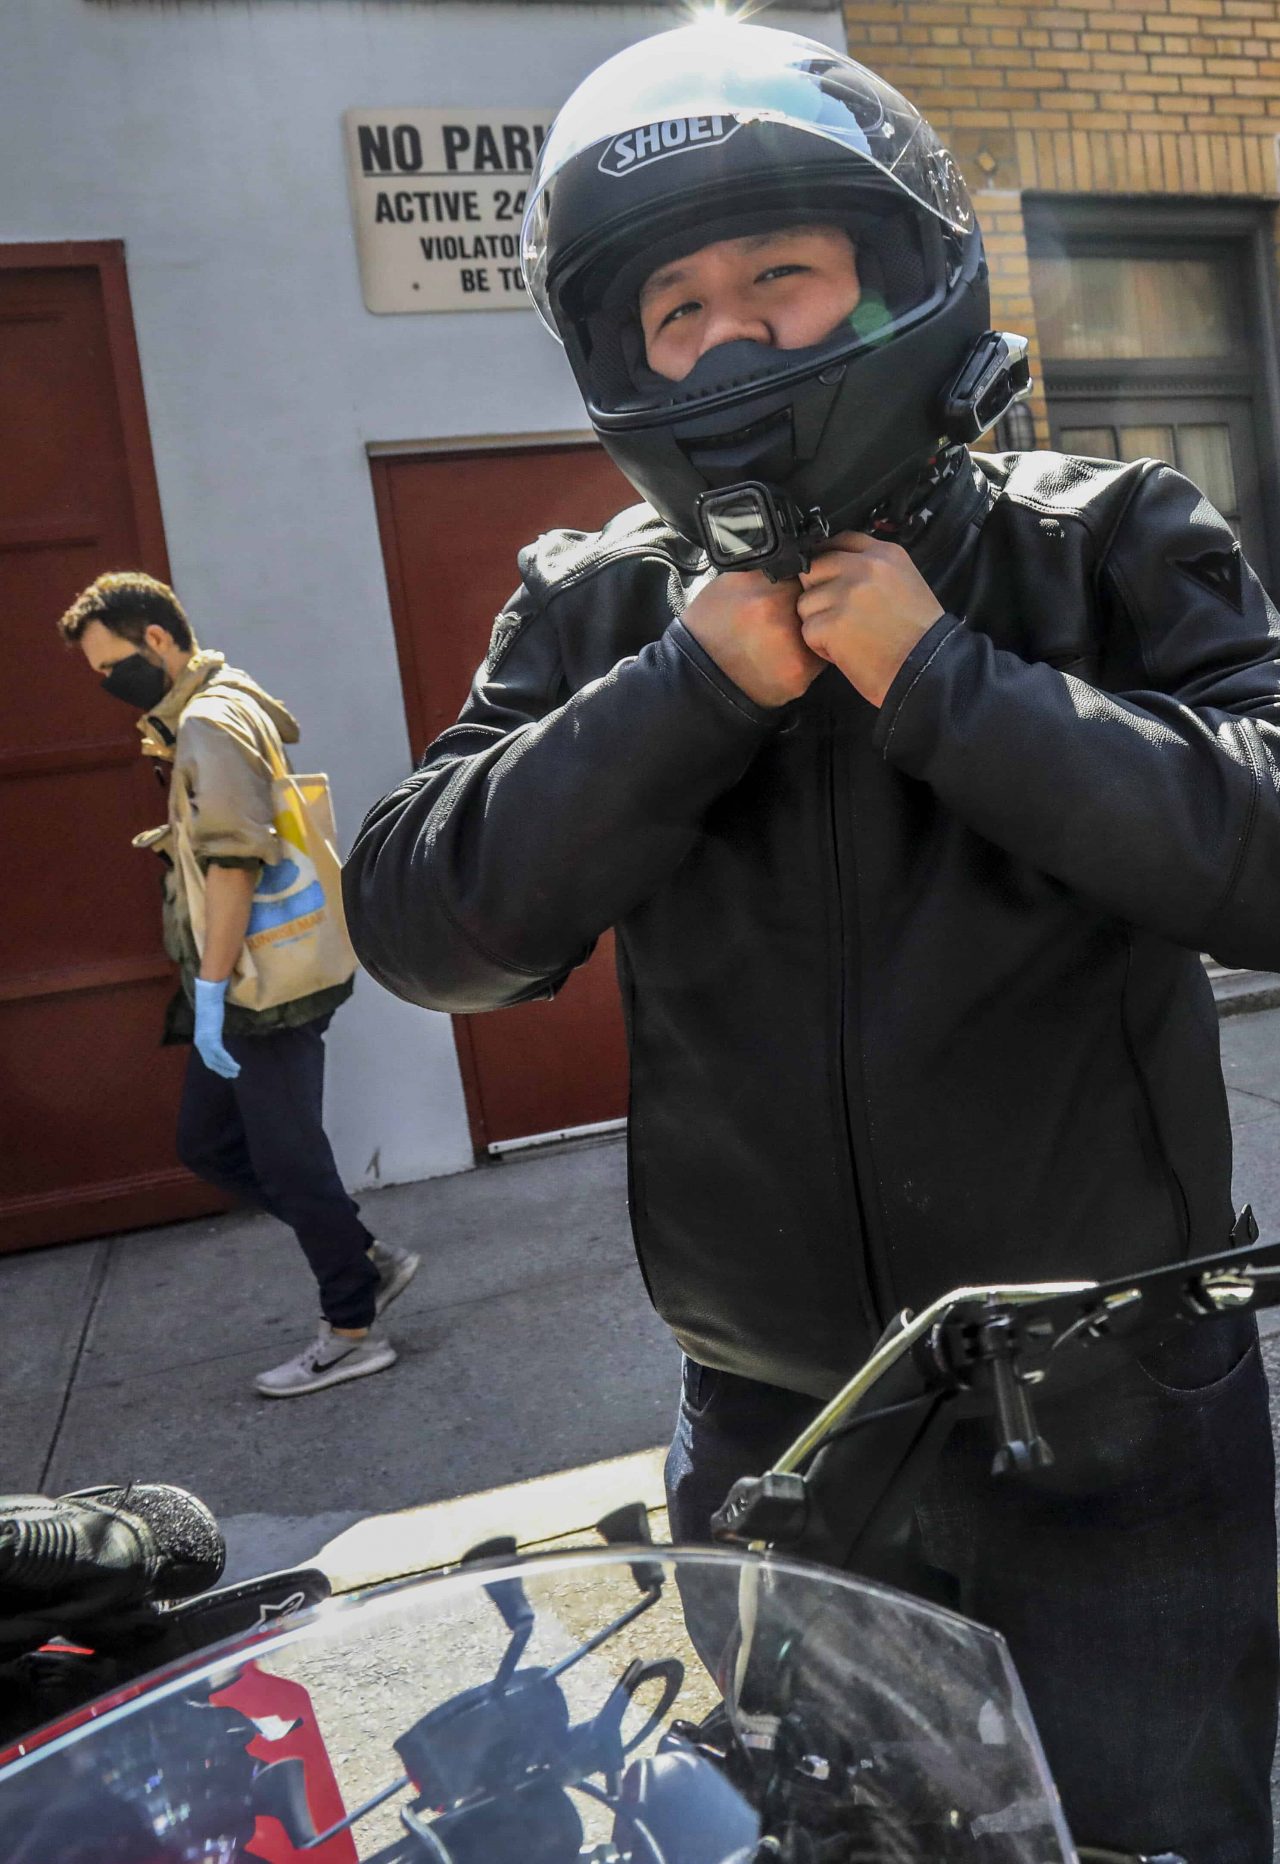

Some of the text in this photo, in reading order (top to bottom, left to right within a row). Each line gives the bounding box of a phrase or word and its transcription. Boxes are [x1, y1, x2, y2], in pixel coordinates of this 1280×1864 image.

[358, 124, 424, 172] NO
[614, 115, 724, 169] SHOEI
[375, 190, 482, 223] ACTIVE
[460, 268, 490, 293] BE
